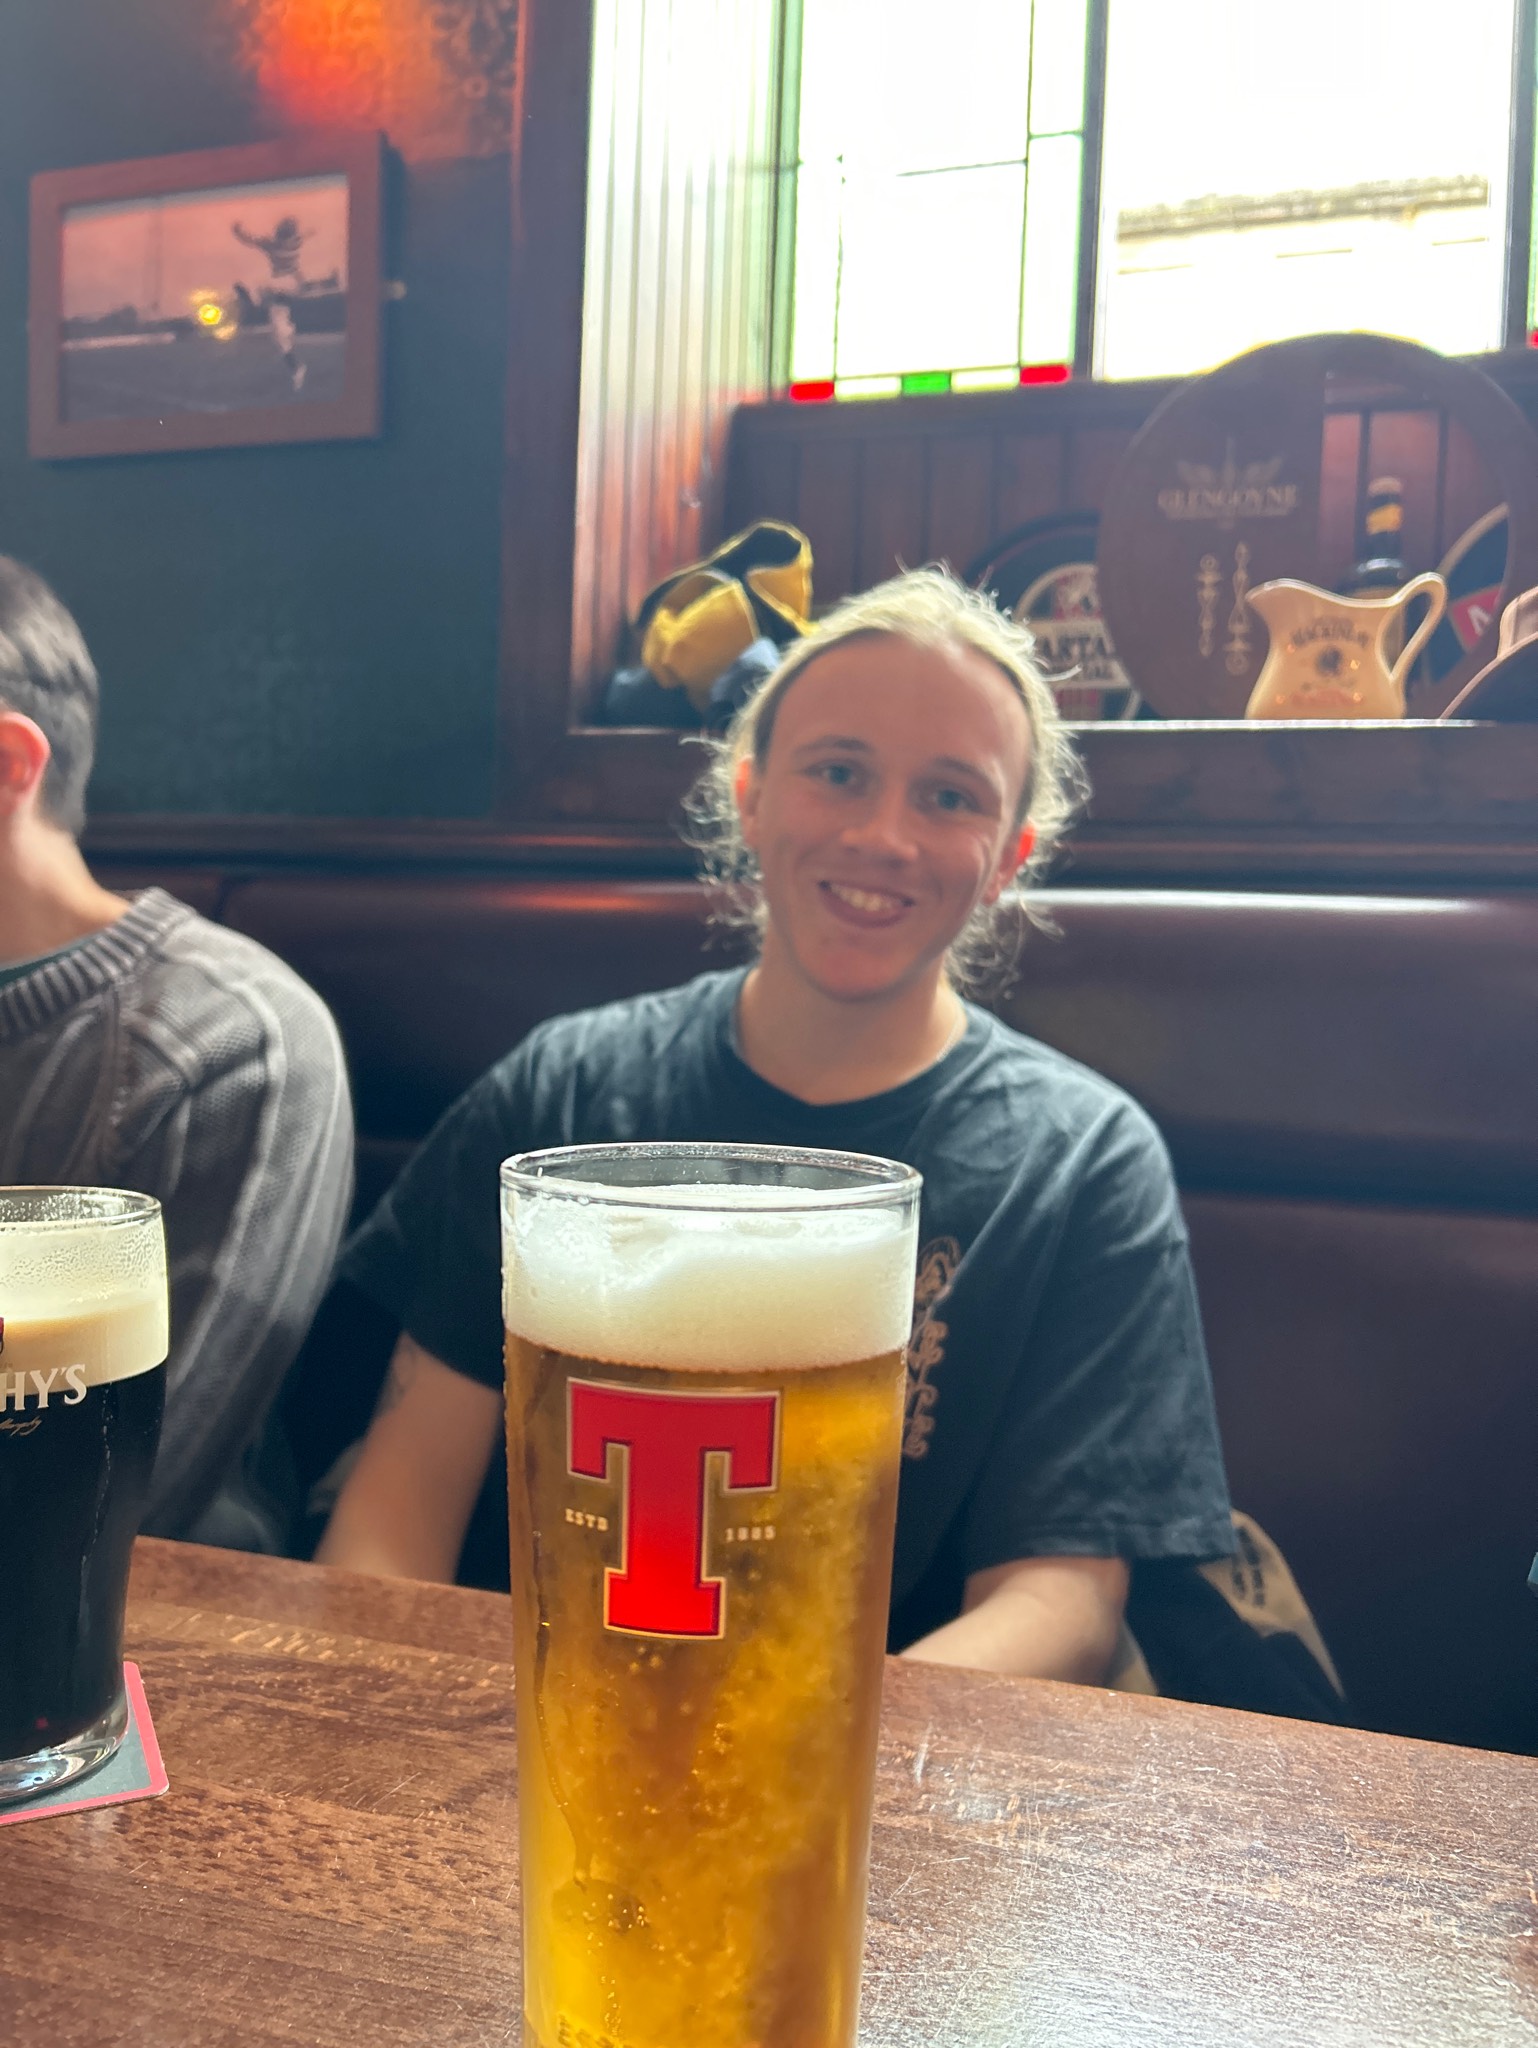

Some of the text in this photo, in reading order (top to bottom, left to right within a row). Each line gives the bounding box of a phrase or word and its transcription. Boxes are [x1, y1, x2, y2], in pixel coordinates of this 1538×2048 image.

[564, 1507, 777, 1544] ESTD 1885
[567, 1376, 781, 1641] T
